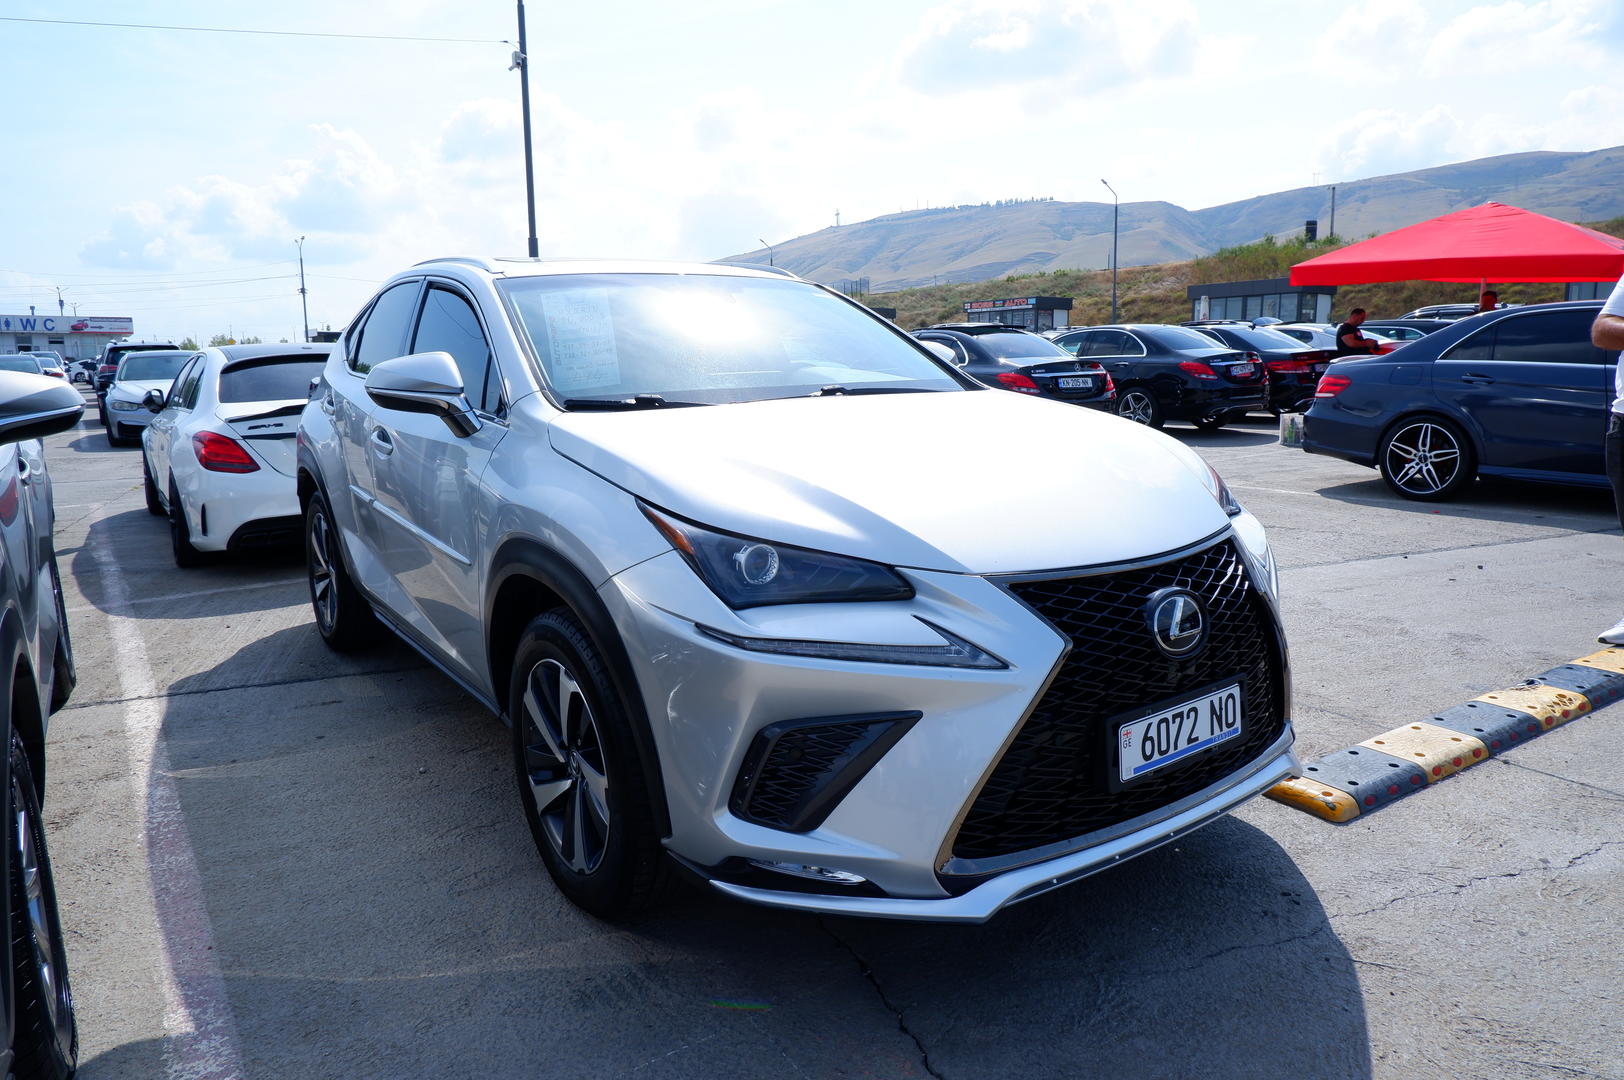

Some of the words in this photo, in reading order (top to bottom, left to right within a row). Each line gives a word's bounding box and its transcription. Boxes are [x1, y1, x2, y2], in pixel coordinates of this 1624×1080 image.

[1004, 298, 1027, 307] AUTO
[1141, 706, 1200, 762] 6072
[1122, 738, 1132, 749] GE
